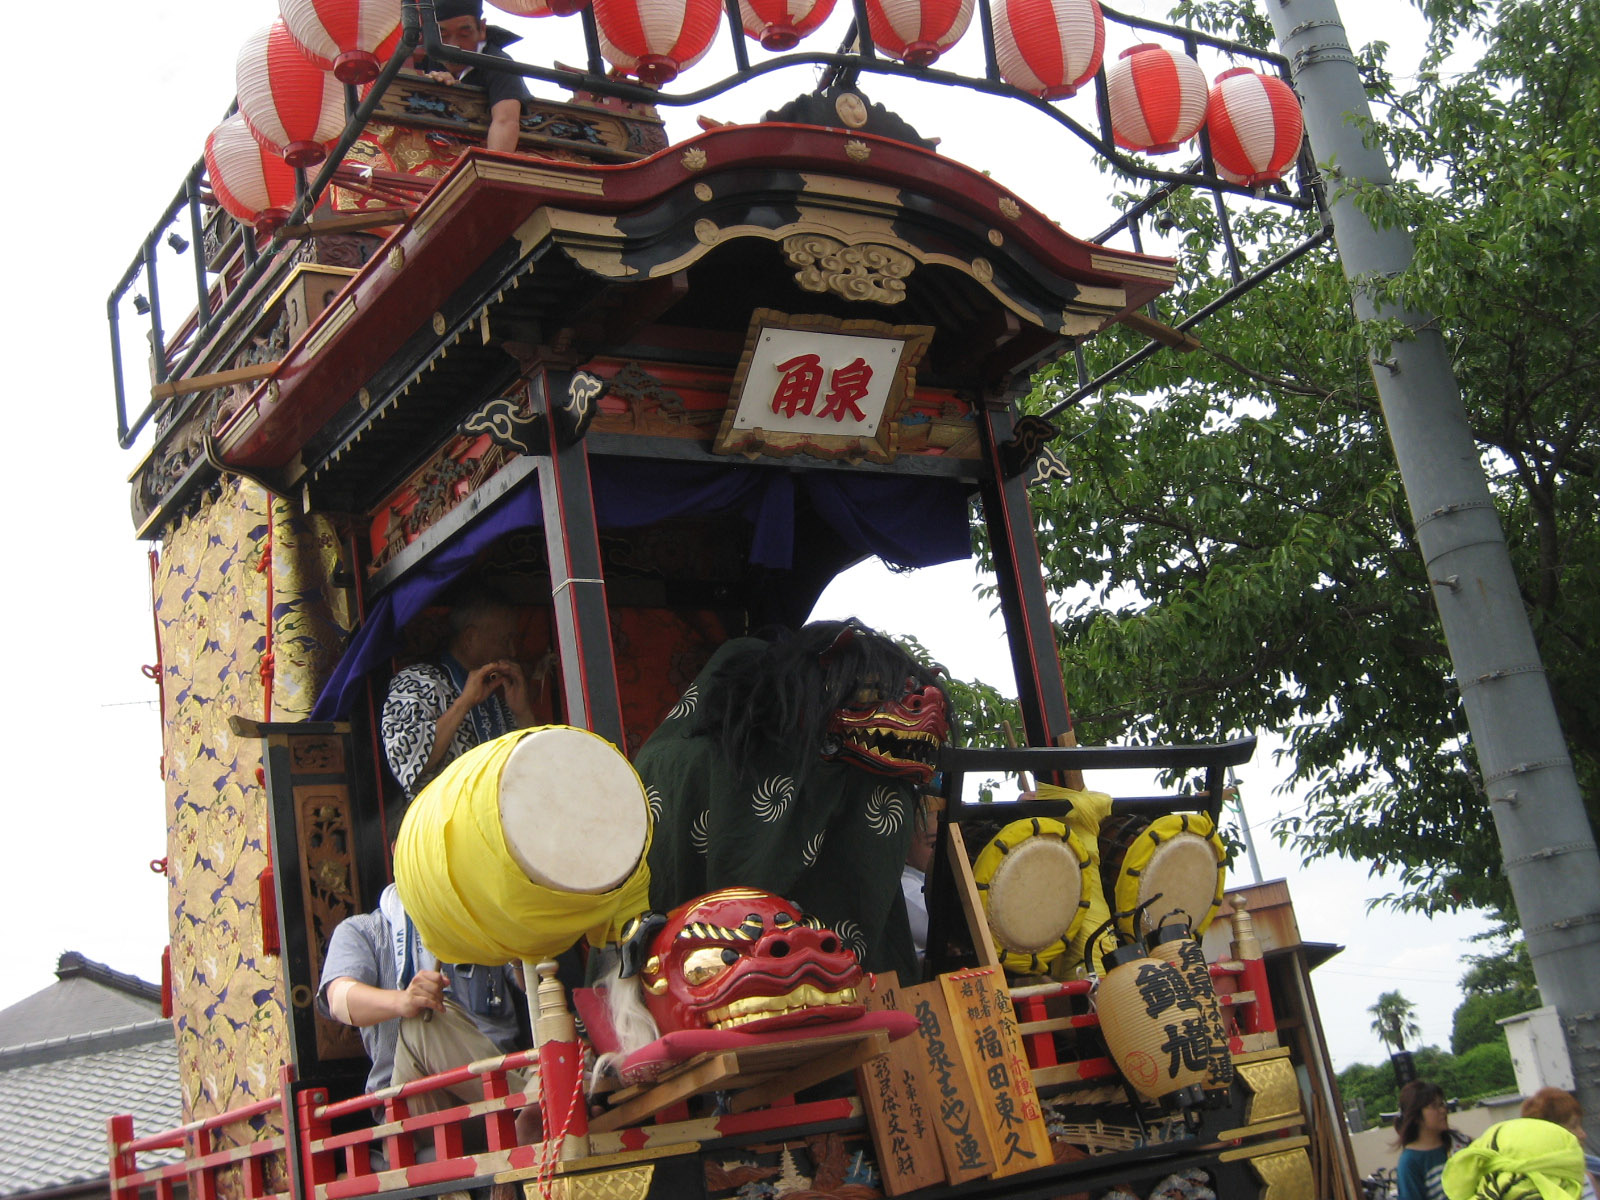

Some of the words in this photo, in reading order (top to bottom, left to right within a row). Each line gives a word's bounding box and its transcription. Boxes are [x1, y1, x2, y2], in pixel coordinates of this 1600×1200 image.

[993, 989, 1018, 1053] 魔除け
[974, 1025, 1037, 1166] 福田東久
